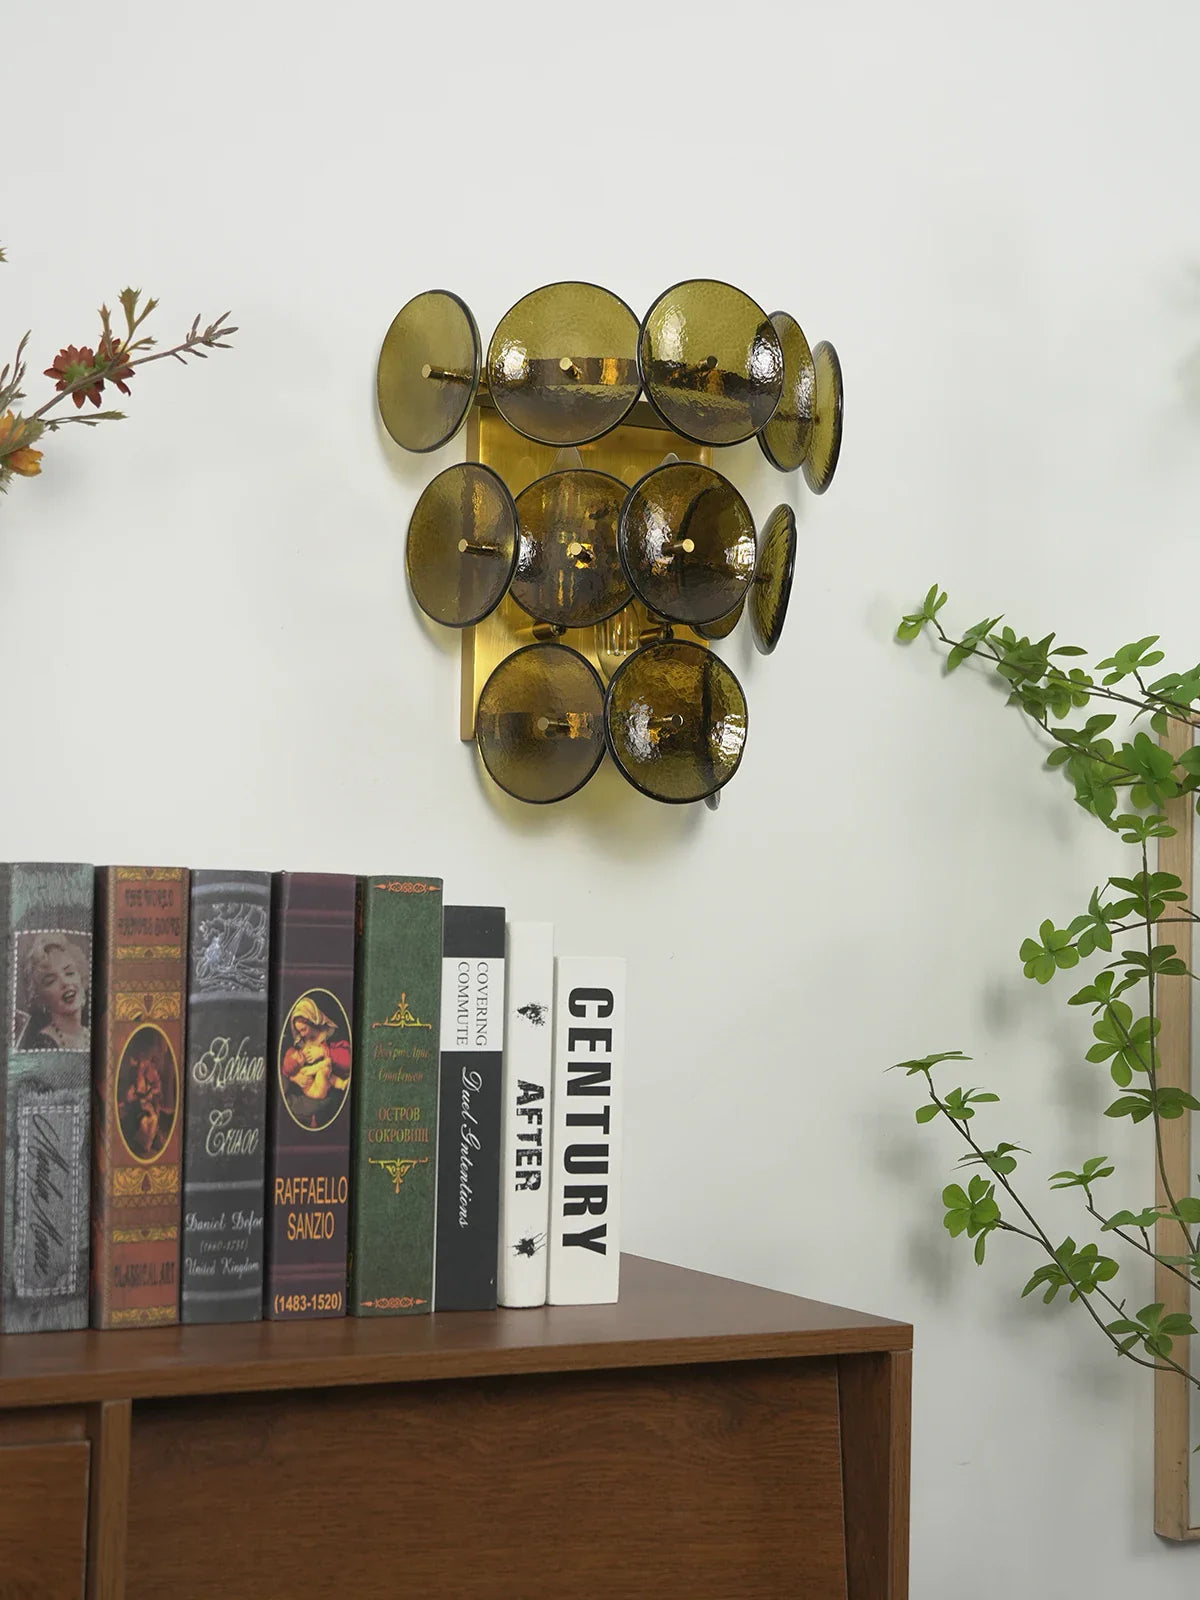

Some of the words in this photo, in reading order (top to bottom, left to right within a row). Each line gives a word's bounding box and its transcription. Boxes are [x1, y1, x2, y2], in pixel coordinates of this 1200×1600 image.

[456, 961, 470, 1046] COMMUTE
[475, 961, 489, 1047] COVERING
[378, 1106, 421, 1121] ОСТРОВ
[562, 987, 614, 1256] CENTURY
[515, 1079, 545, 1192] AFTER
[274, 1175, 349, 1206] RAFFAELLO
[458, 1123, 481, 1228] Intentions
[185, 1212, 226, 1232] Daniel
[287, 1211, 335, 1241] SANZIO
[185, 1257, 216, 1277] United
[221, 1257, 260, 1280] Kingdom
[274, 1291, 343, 1315] (1483-1520)
